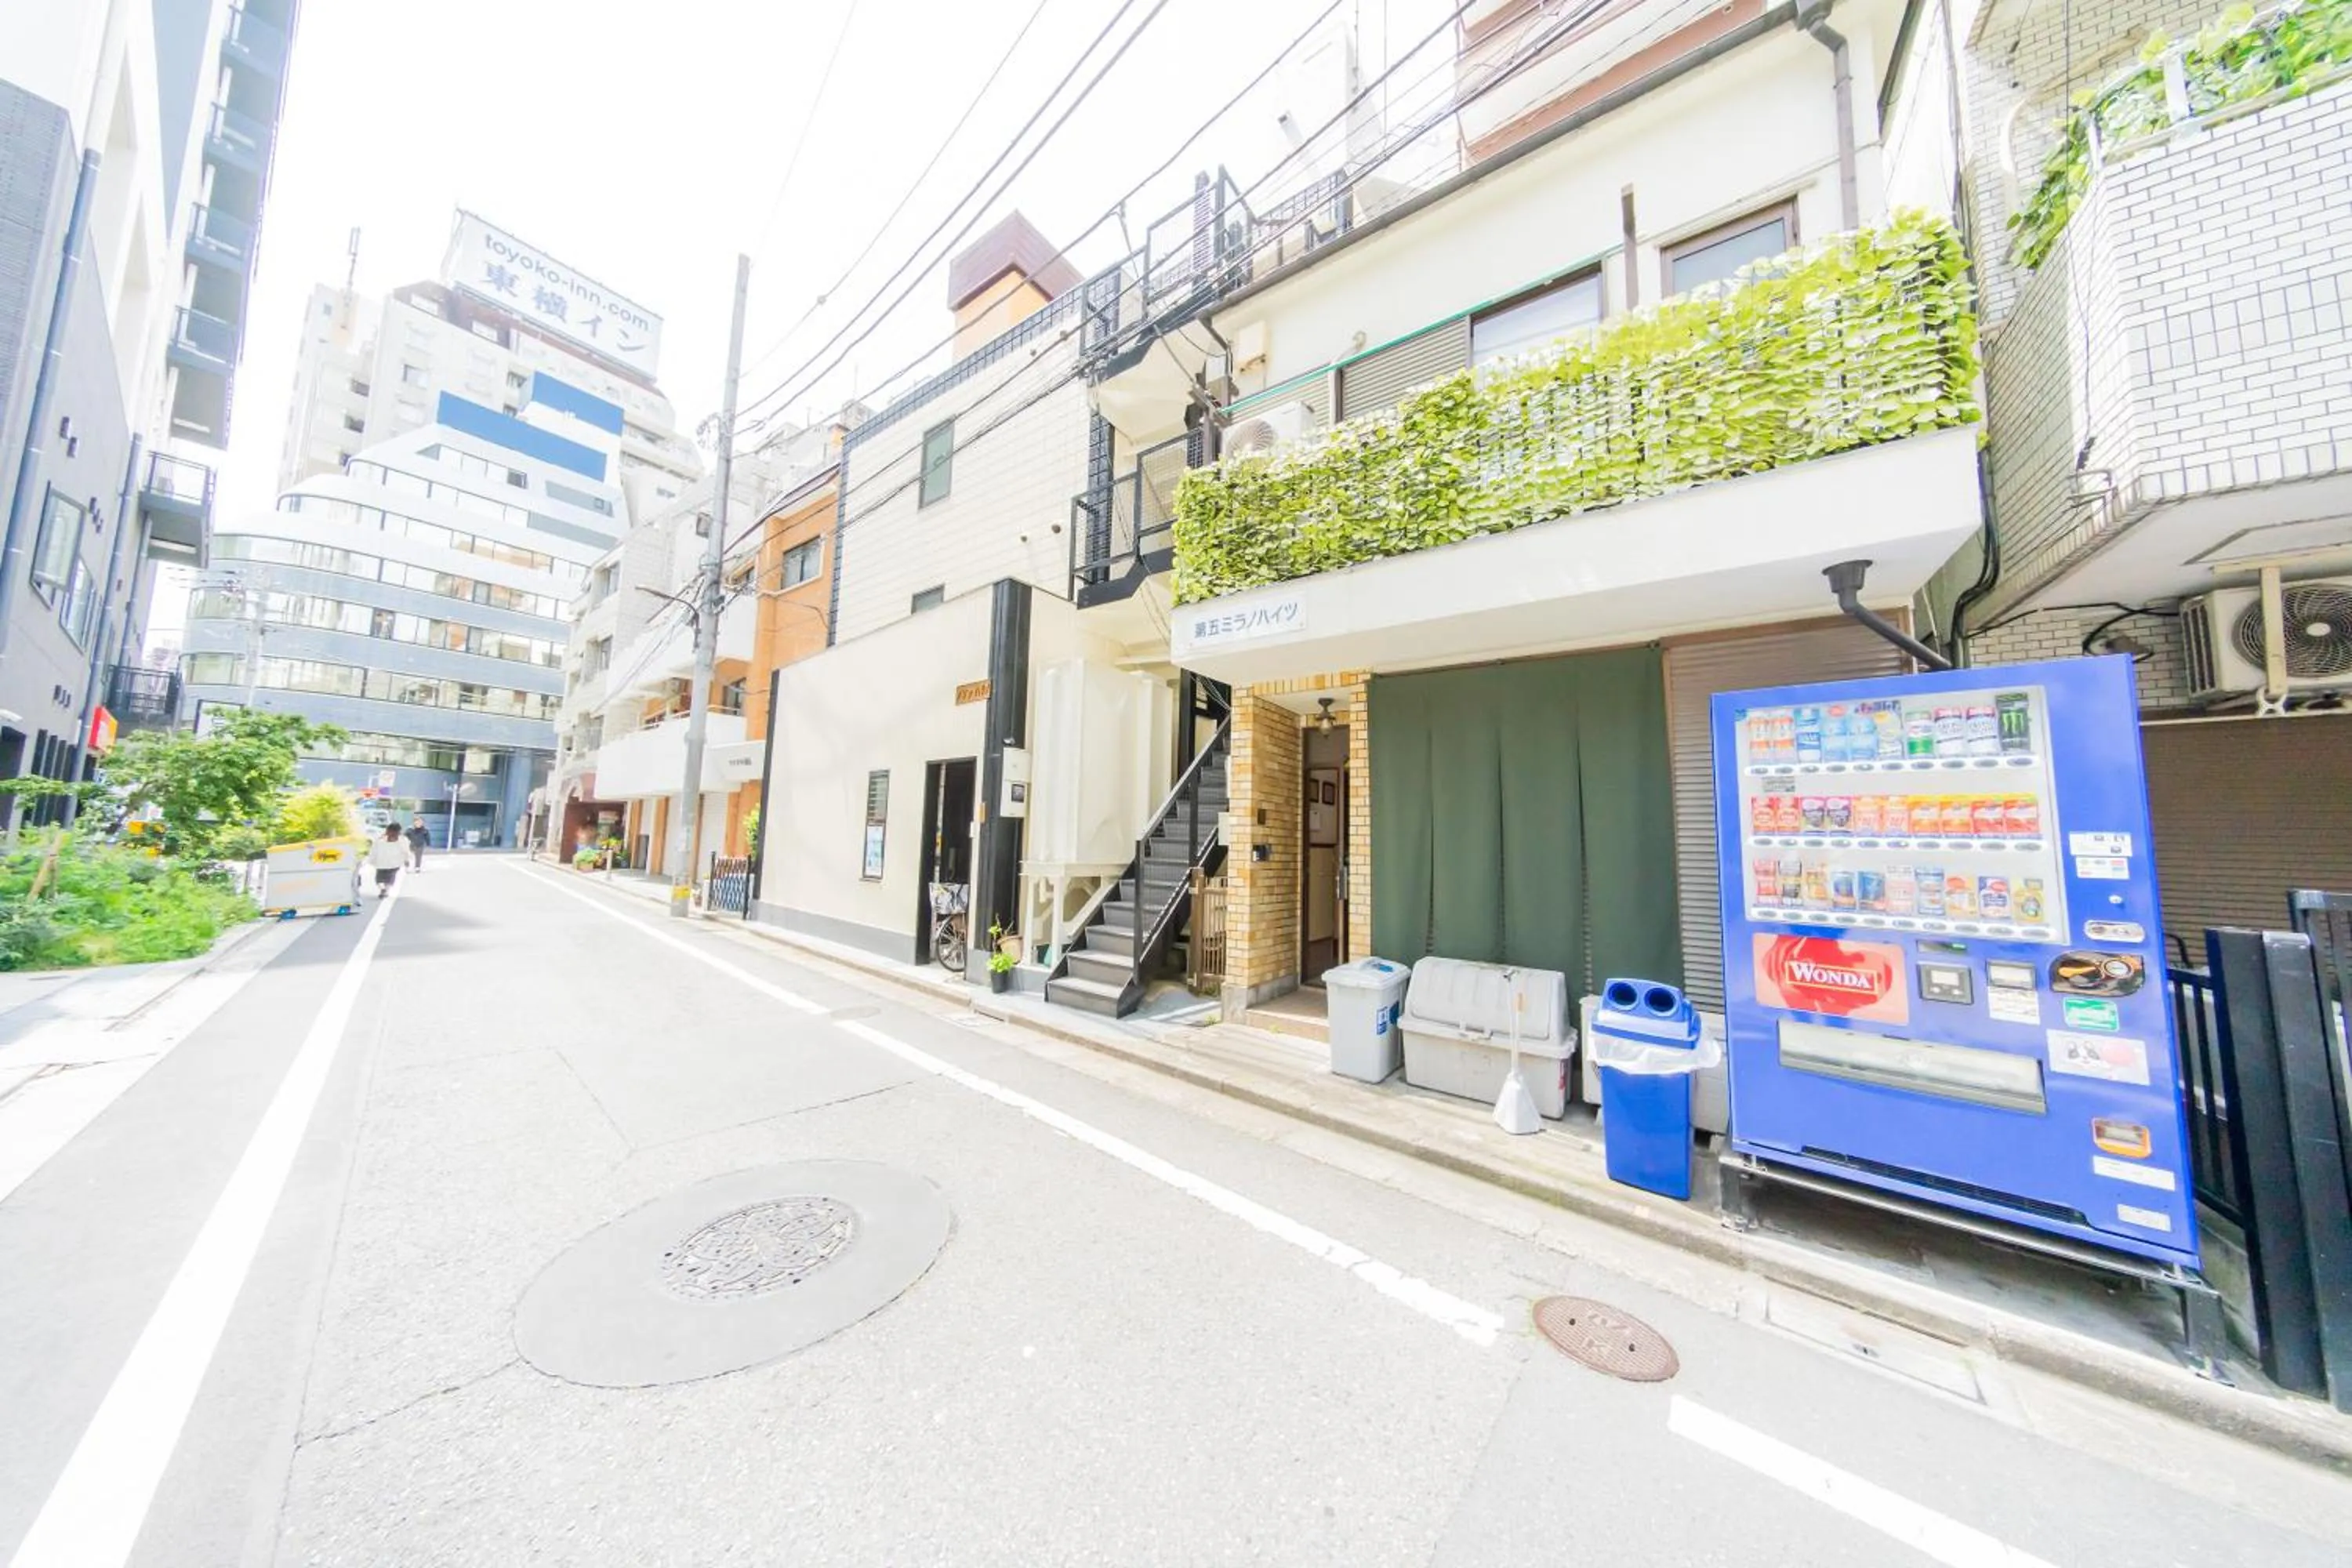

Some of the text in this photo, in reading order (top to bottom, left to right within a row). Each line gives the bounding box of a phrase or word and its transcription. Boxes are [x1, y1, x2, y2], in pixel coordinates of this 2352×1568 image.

[484, 234, 649, 332] toyoko-inn.com
[1194, 601, 1298, 638] 第五ミラノハイツ
[1788, 960, 1871, 989] WONDA
